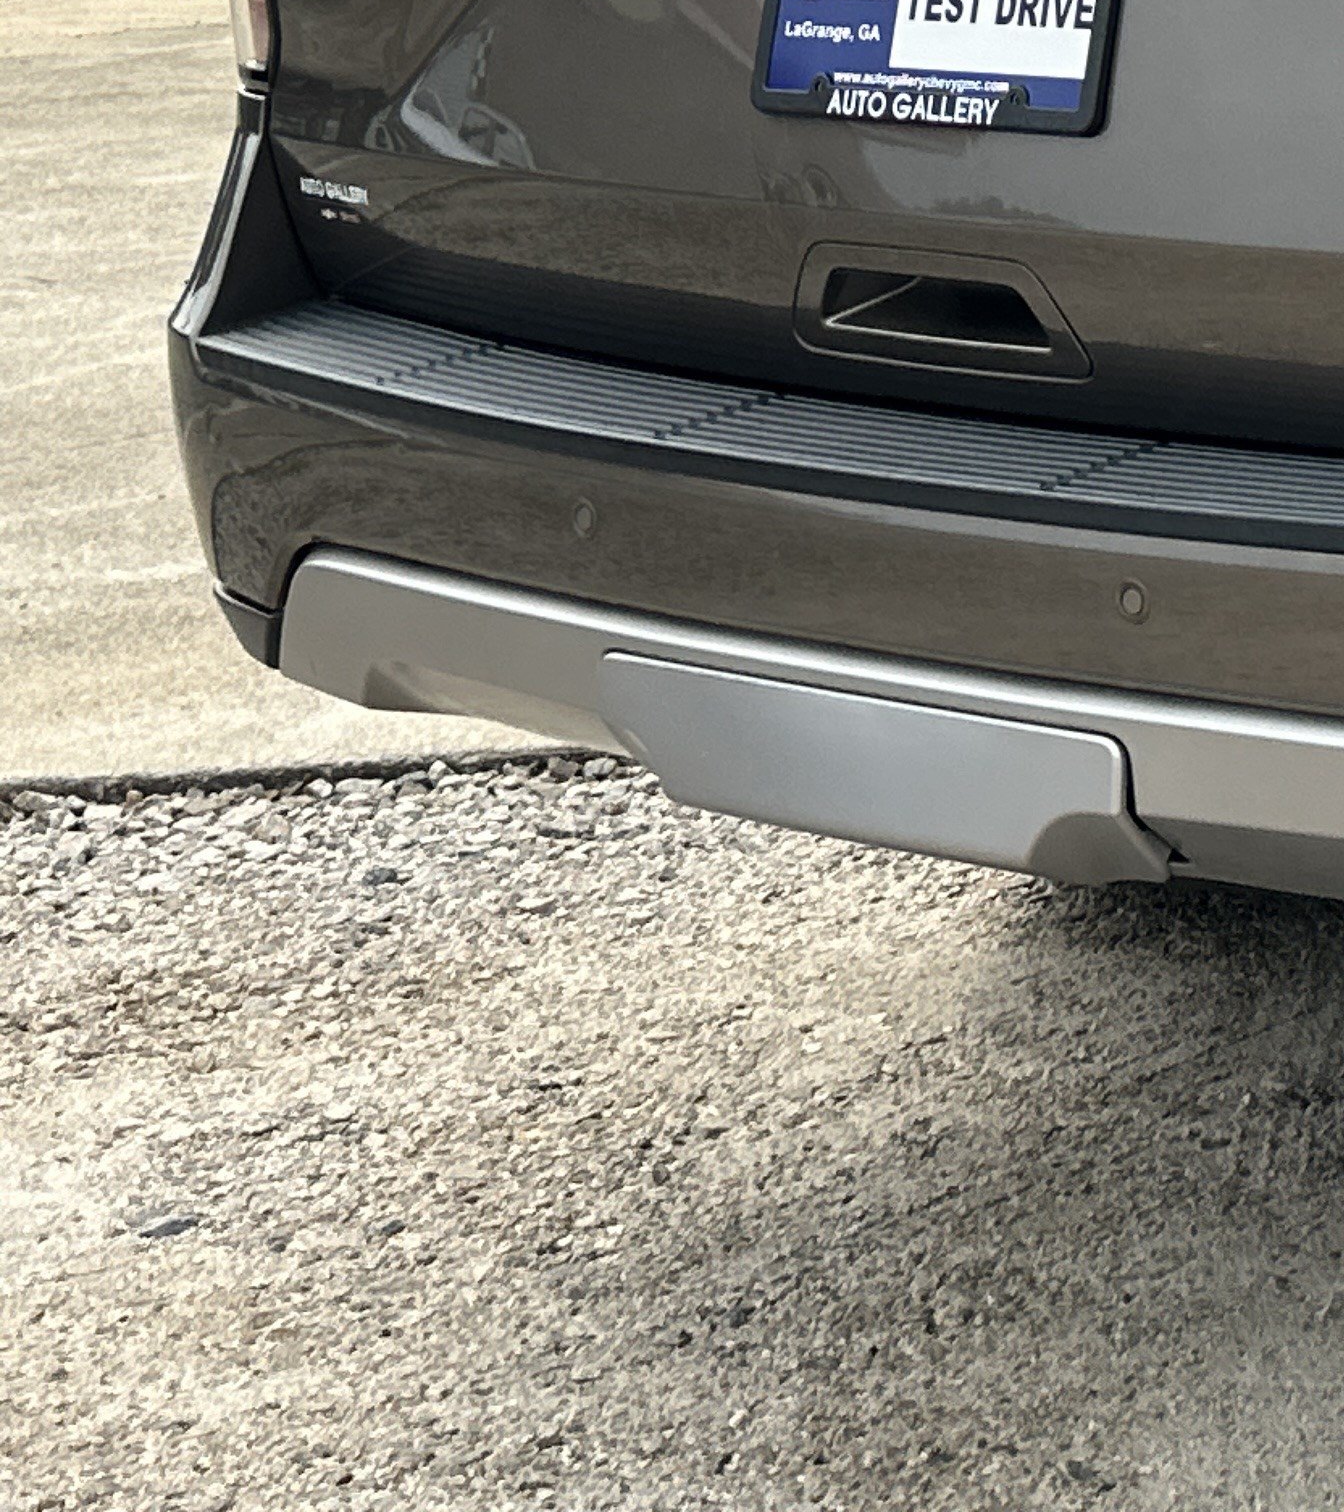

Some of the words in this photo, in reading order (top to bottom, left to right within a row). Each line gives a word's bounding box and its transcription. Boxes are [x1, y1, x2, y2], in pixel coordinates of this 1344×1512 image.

[784, 20, 855, 43] LaGrange,
[858, 23, 881, 42] GA
[826, 89, 887, 118] AUTO
[892, 93, 1000, 125] GALLERY
